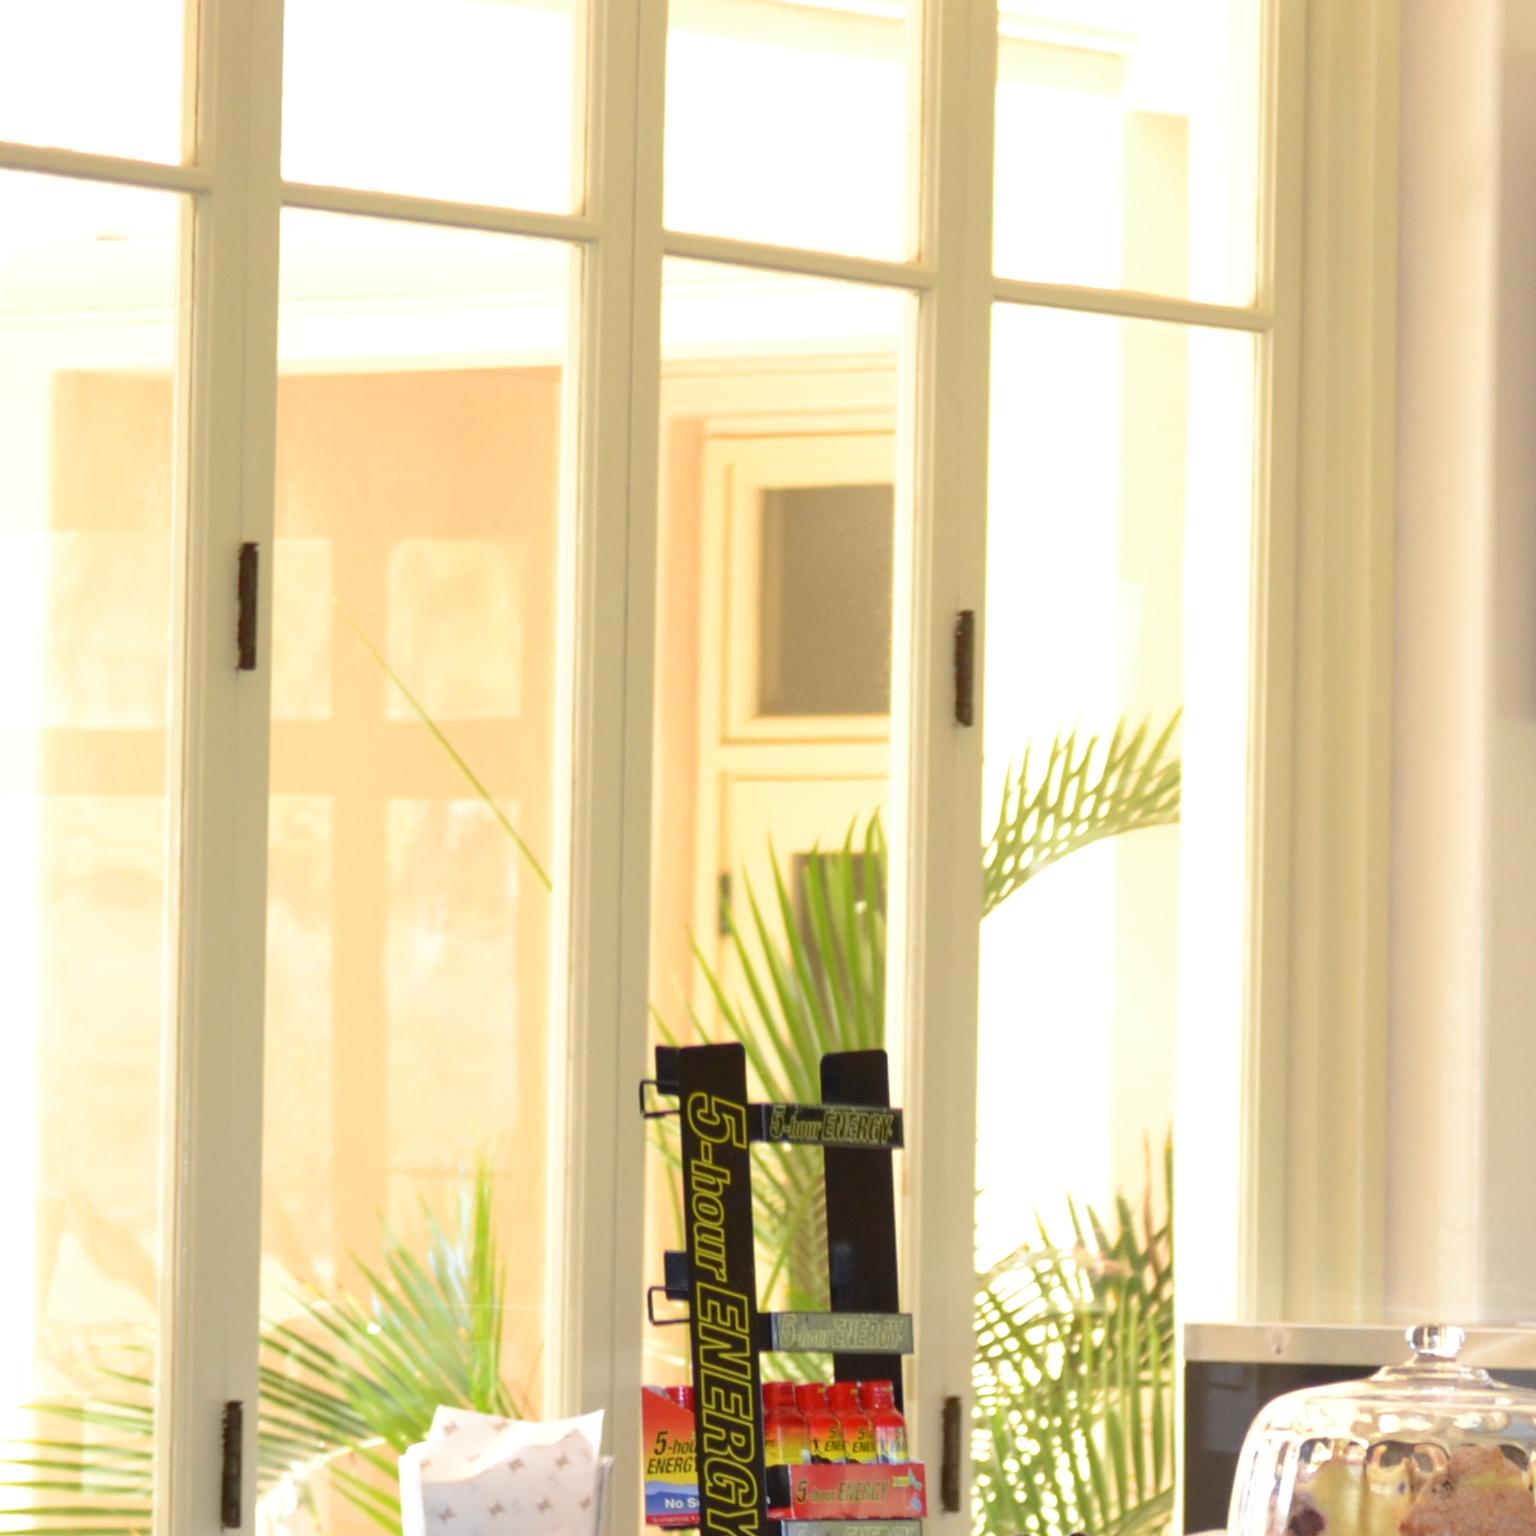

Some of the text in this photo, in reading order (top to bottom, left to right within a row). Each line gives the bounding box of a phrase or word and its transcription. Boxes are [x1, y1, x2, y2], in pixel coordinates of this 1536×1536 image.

[822, 1111, 894, 1144] ENERGY
[688, 1091, 748, 1282] 5-hour
[665, 1499, 684, 1509] No
[838, 1481, 888, 1501] ENERGY
